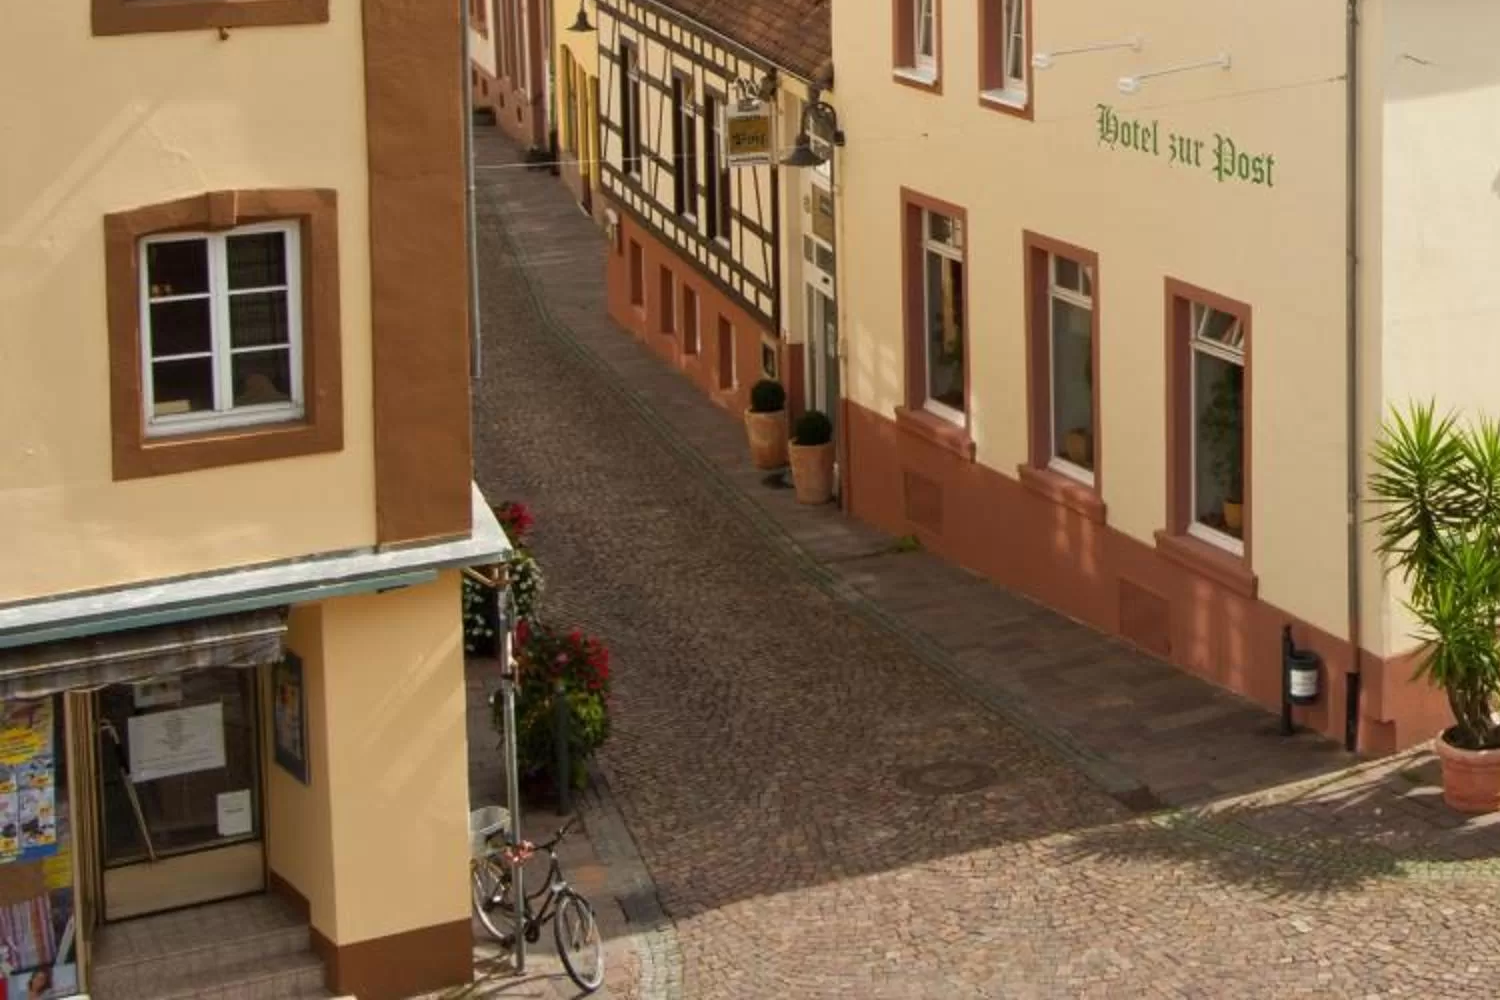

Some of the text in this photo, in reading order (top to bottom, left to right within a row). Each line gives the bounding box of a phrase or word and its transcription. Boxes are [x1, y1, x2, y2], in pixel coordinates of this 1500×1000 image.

[1096, 103, 1275, 188] Hotel zur Post
